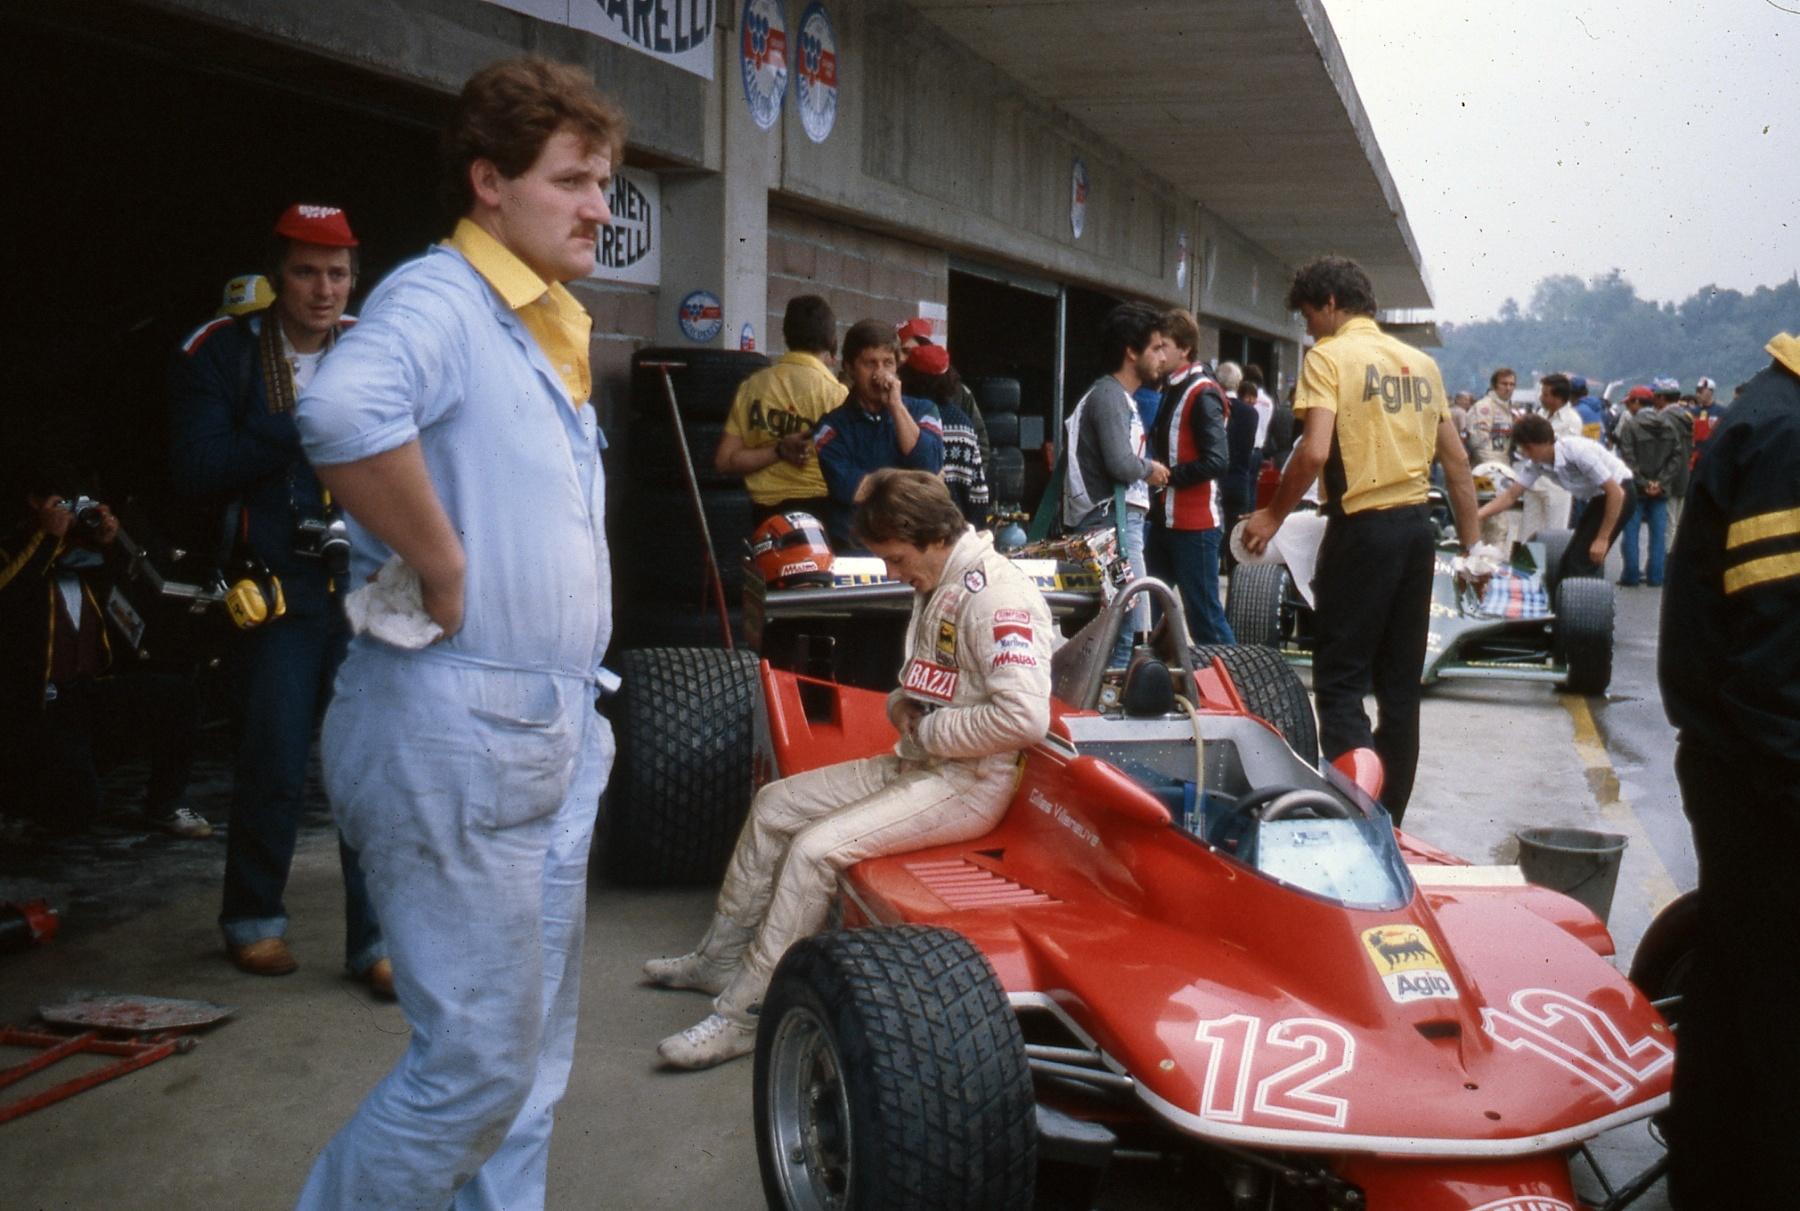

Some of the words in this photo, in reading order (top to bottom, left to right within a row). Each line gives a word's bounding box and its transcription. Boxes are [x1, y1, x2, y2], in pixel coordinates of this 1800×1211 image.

[596, 0, 712, 54] ARELLI
[1362, 363, 1432, 414] Agip
[907, 663, 958, 698] BAZZI
[1397, 971, 1450, 996] Agip
[1196, 1013, 1356, 1128] 12
[1479, 988, 1674, 1102] 12
